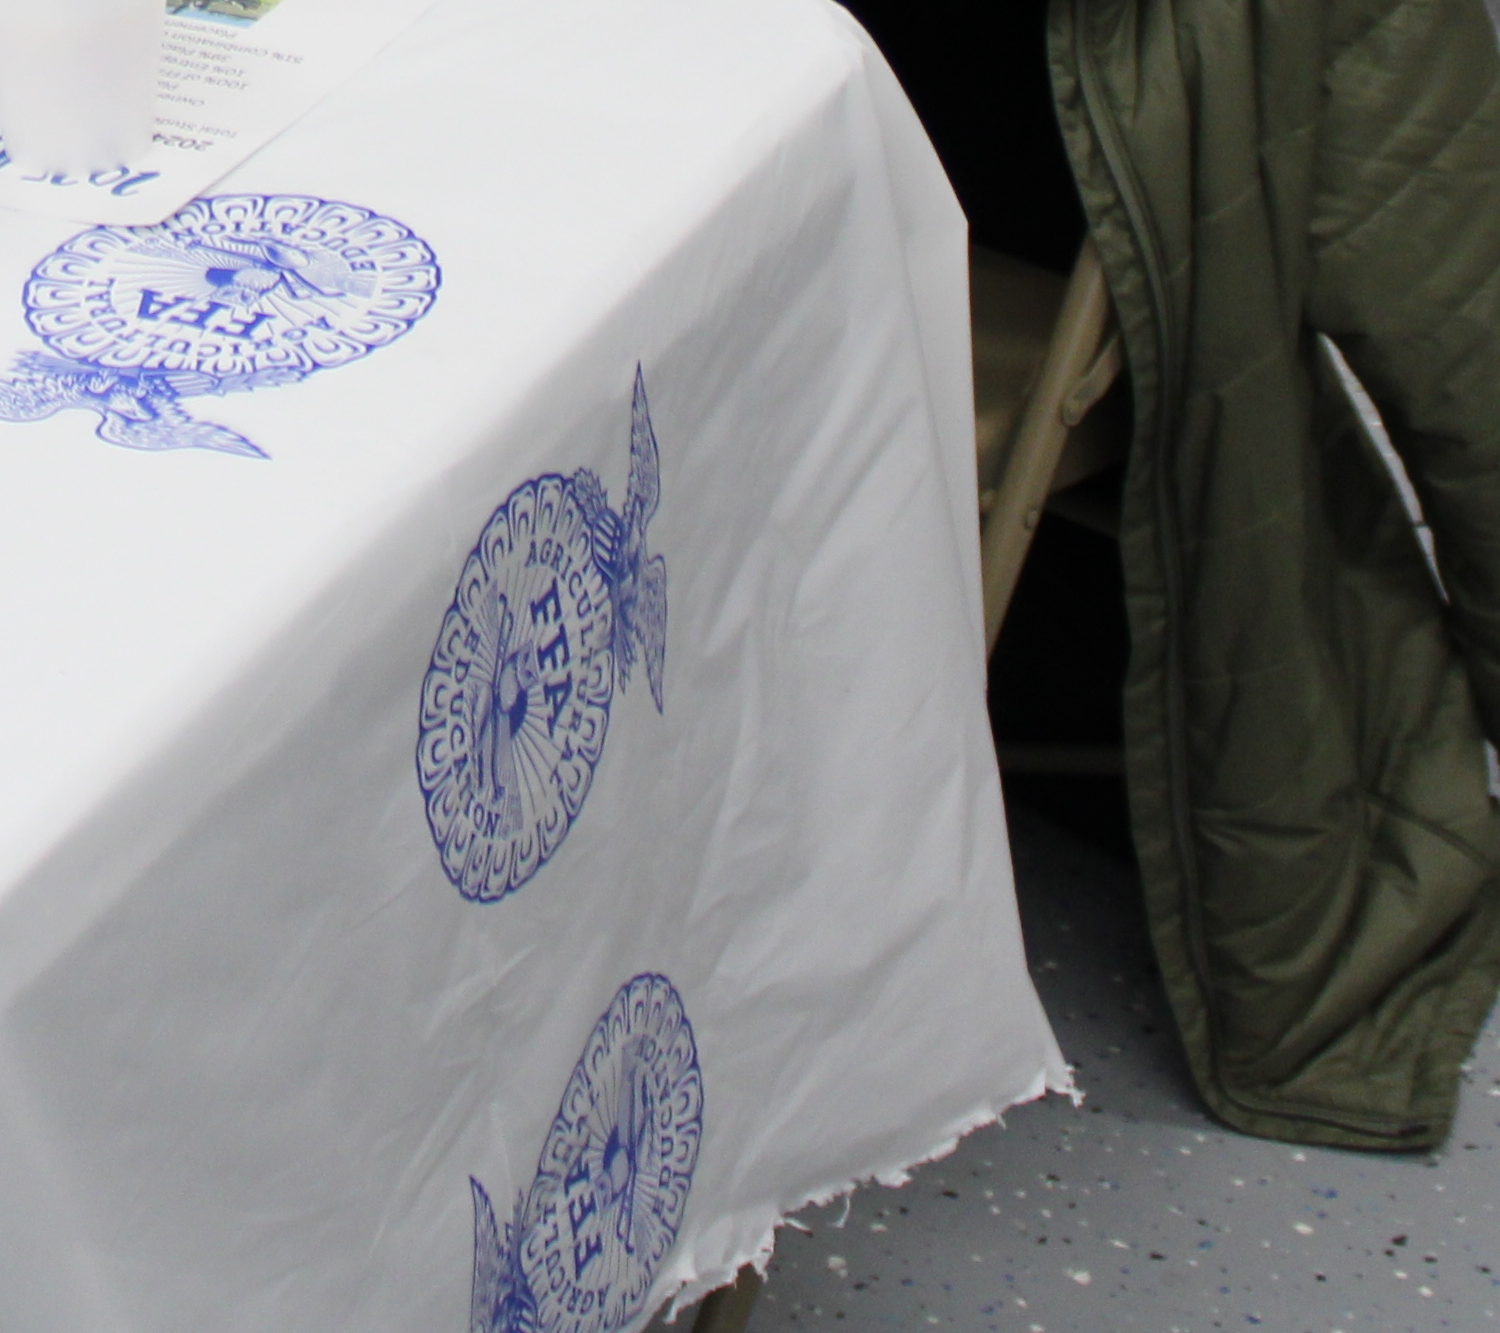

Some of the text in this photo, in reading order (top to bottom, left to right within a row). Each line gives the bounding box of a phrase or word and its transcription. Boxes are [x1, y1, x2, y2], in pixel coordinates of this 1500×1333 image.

[171, 33, 269, 57] Combination
[152, 133, 214, 151] 2024
[173, 220, 379, 275] EDUCATION
[83, 276, 330, 357] AGRICULTURAL
[136, 289, 275, 339] FFA
[524, 536, 602, 788] AGRICULTURAL
[530, 578, 575, 738] FFA
[448, 632, 500, 839] EDUCATION
[564, 1151, 603, 1281] FFA
